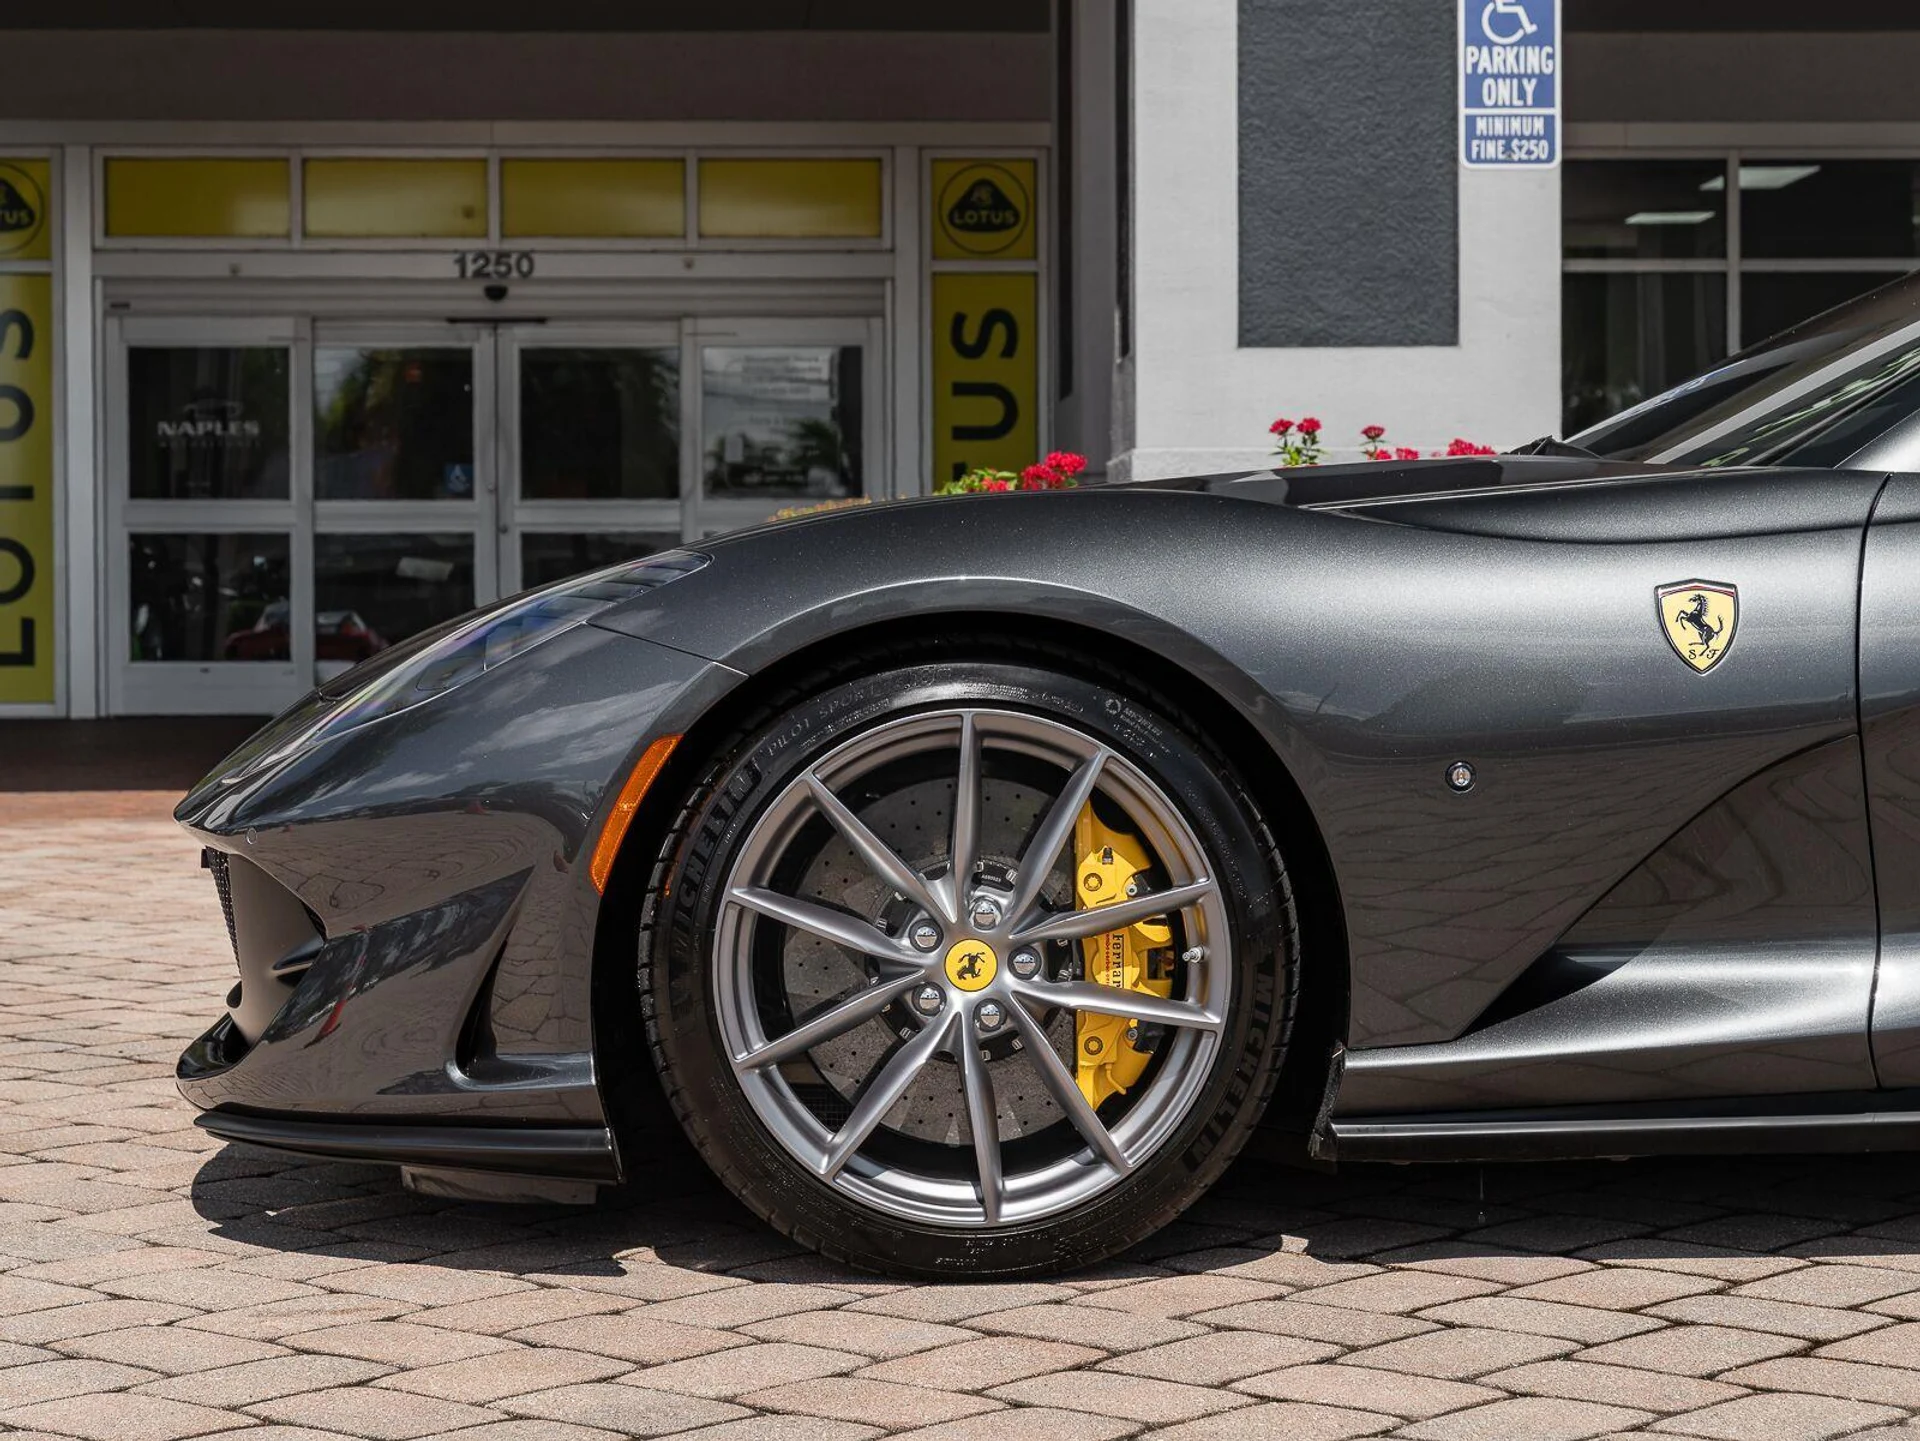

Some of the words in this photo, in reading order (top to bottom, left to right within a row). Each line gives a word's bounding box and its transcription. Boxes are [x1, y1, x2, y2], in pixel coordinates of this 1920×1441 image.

[1465, 45, 1554, 75] PARKING
[1482, 77, 1537, 107] ONLY
[1476, 116, 1545, 137] MINIMUM
[1471, 139, 1505, 161] FINE
[1511, 138, 1549, 162] $250
[953, 209, 1016, 225] LOTUS
[454, 251, 535, 279] 1250
[951, 308, 1019, 482] US
[157, 420, 260, 437] NAPLES
[1112, 933, 1125, 988] Ferrar
[1191, 972, 1275, 1162] MICHELIN
